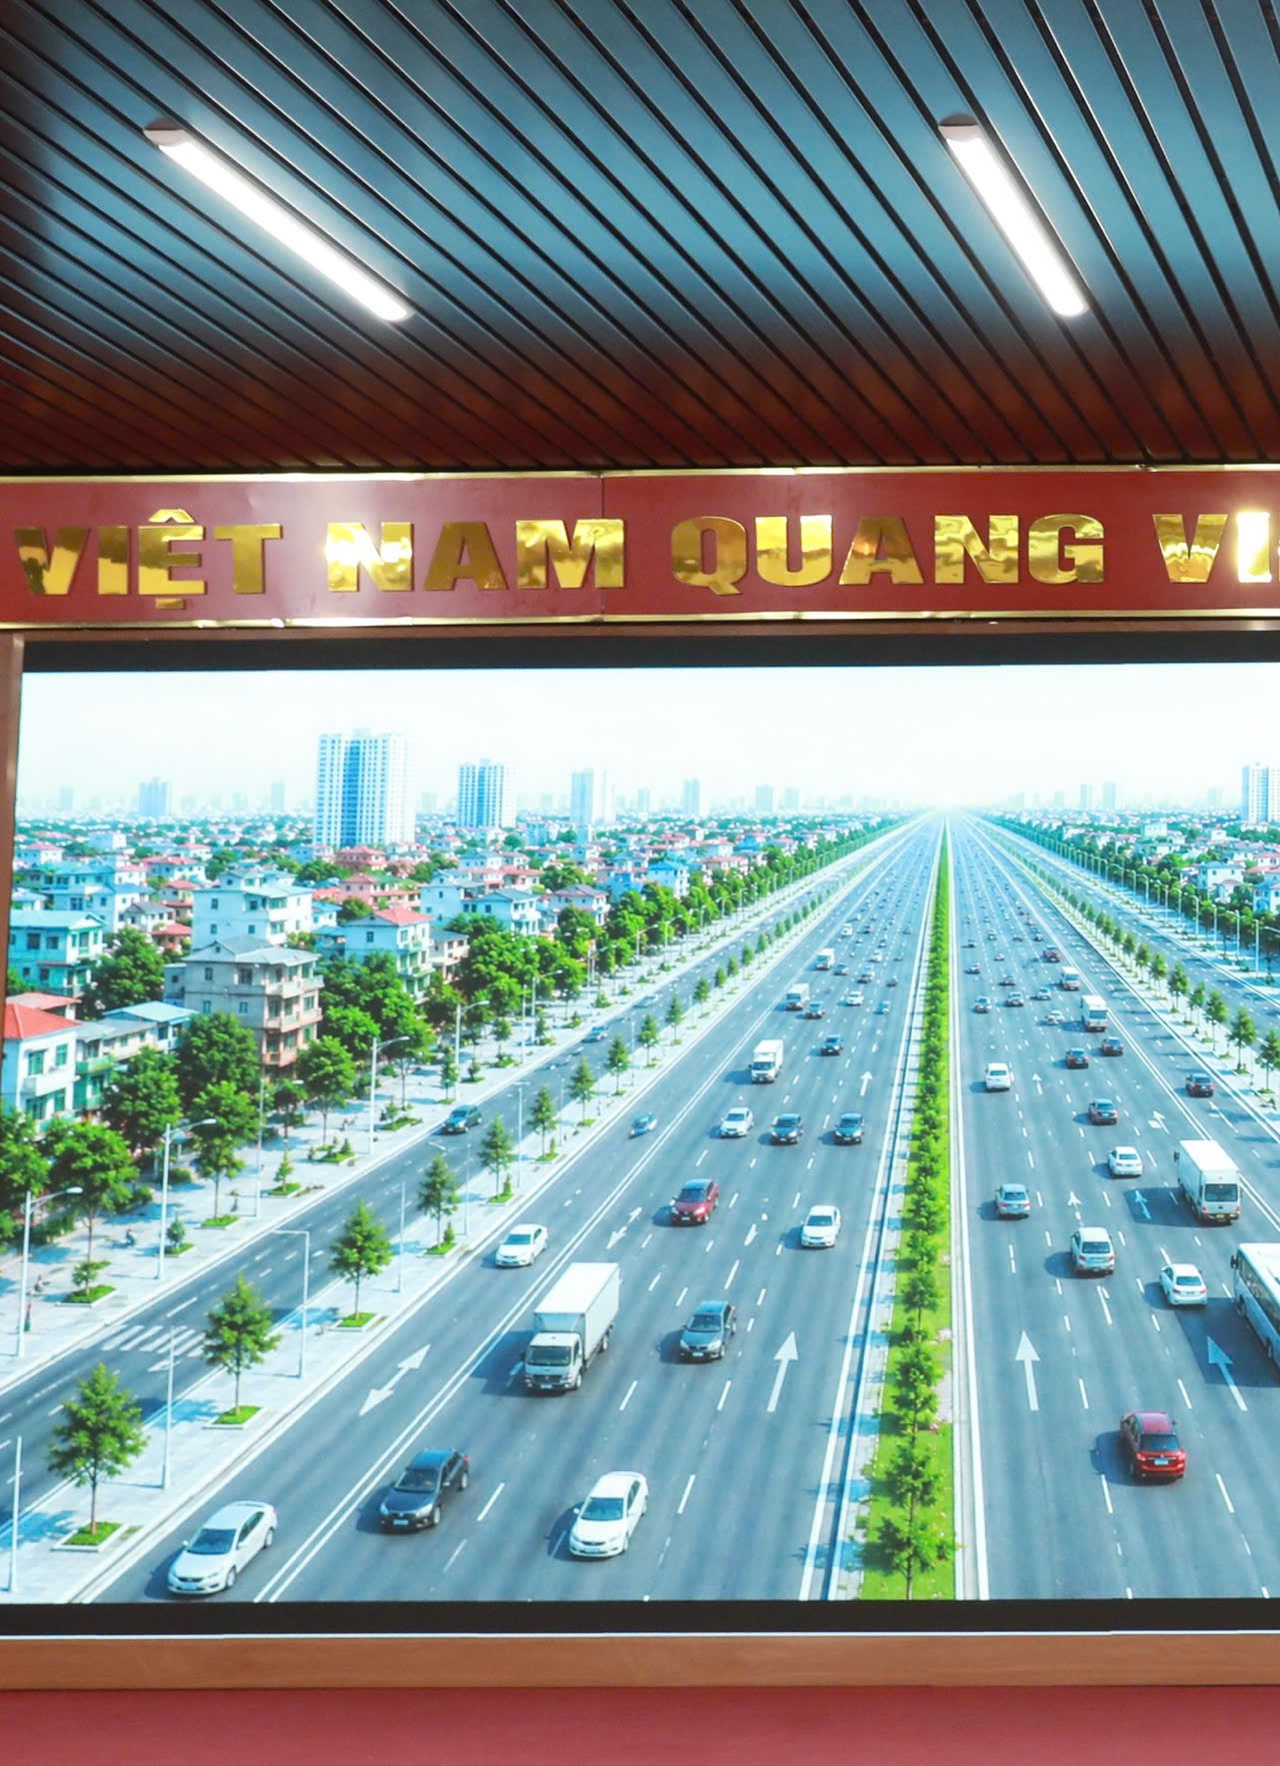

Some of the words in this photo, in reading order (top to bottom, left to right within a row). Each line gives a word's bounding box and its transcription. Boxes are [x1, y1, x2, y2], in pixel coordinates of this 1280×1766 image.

[14, 508, 283, 610] VIỆT
[322, 518, 626, 593] NAM
[670, 513, 1105, 596] QUANG
